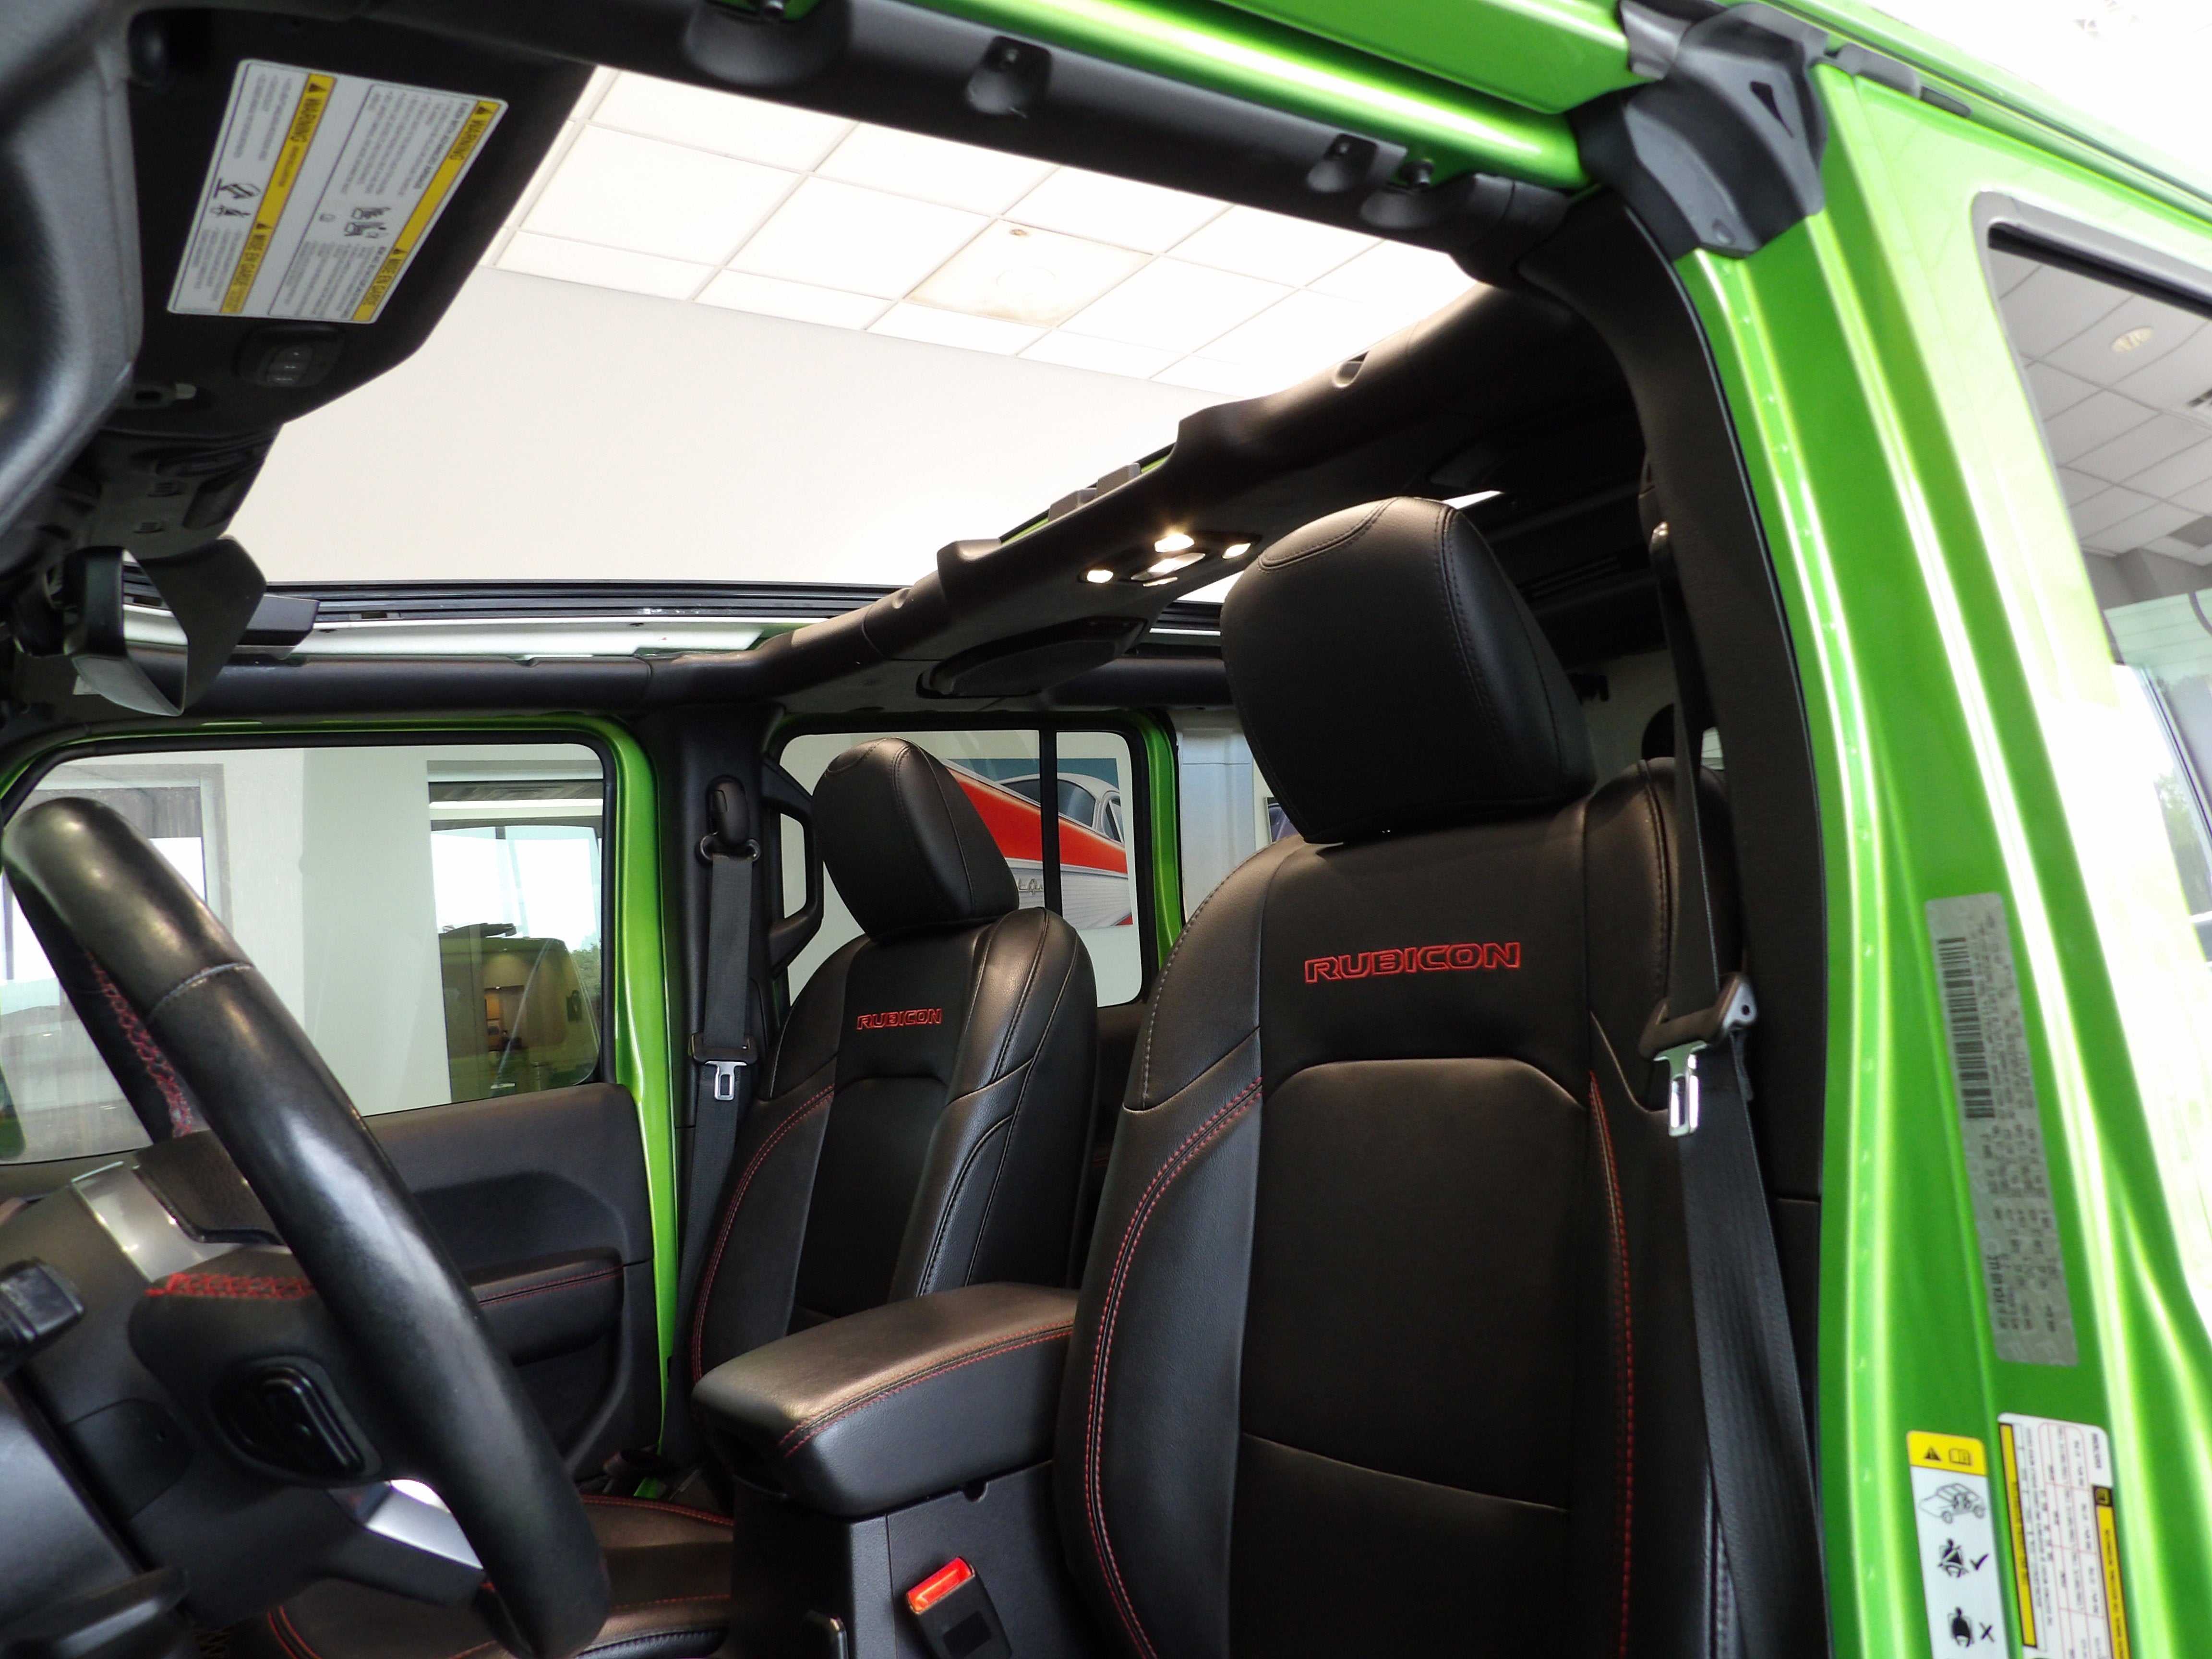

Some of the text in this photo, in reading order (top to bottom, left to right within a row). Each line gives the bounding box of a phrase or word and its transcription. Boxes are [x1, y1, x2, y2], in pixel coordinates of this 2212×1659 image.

[290, 97, 321, 143] WARNING
[449, 119, 485, 160] WARNING
[1305, 942, 1520, 984] RUBICON
[857, 1008, 942, 1030] RUBICON
